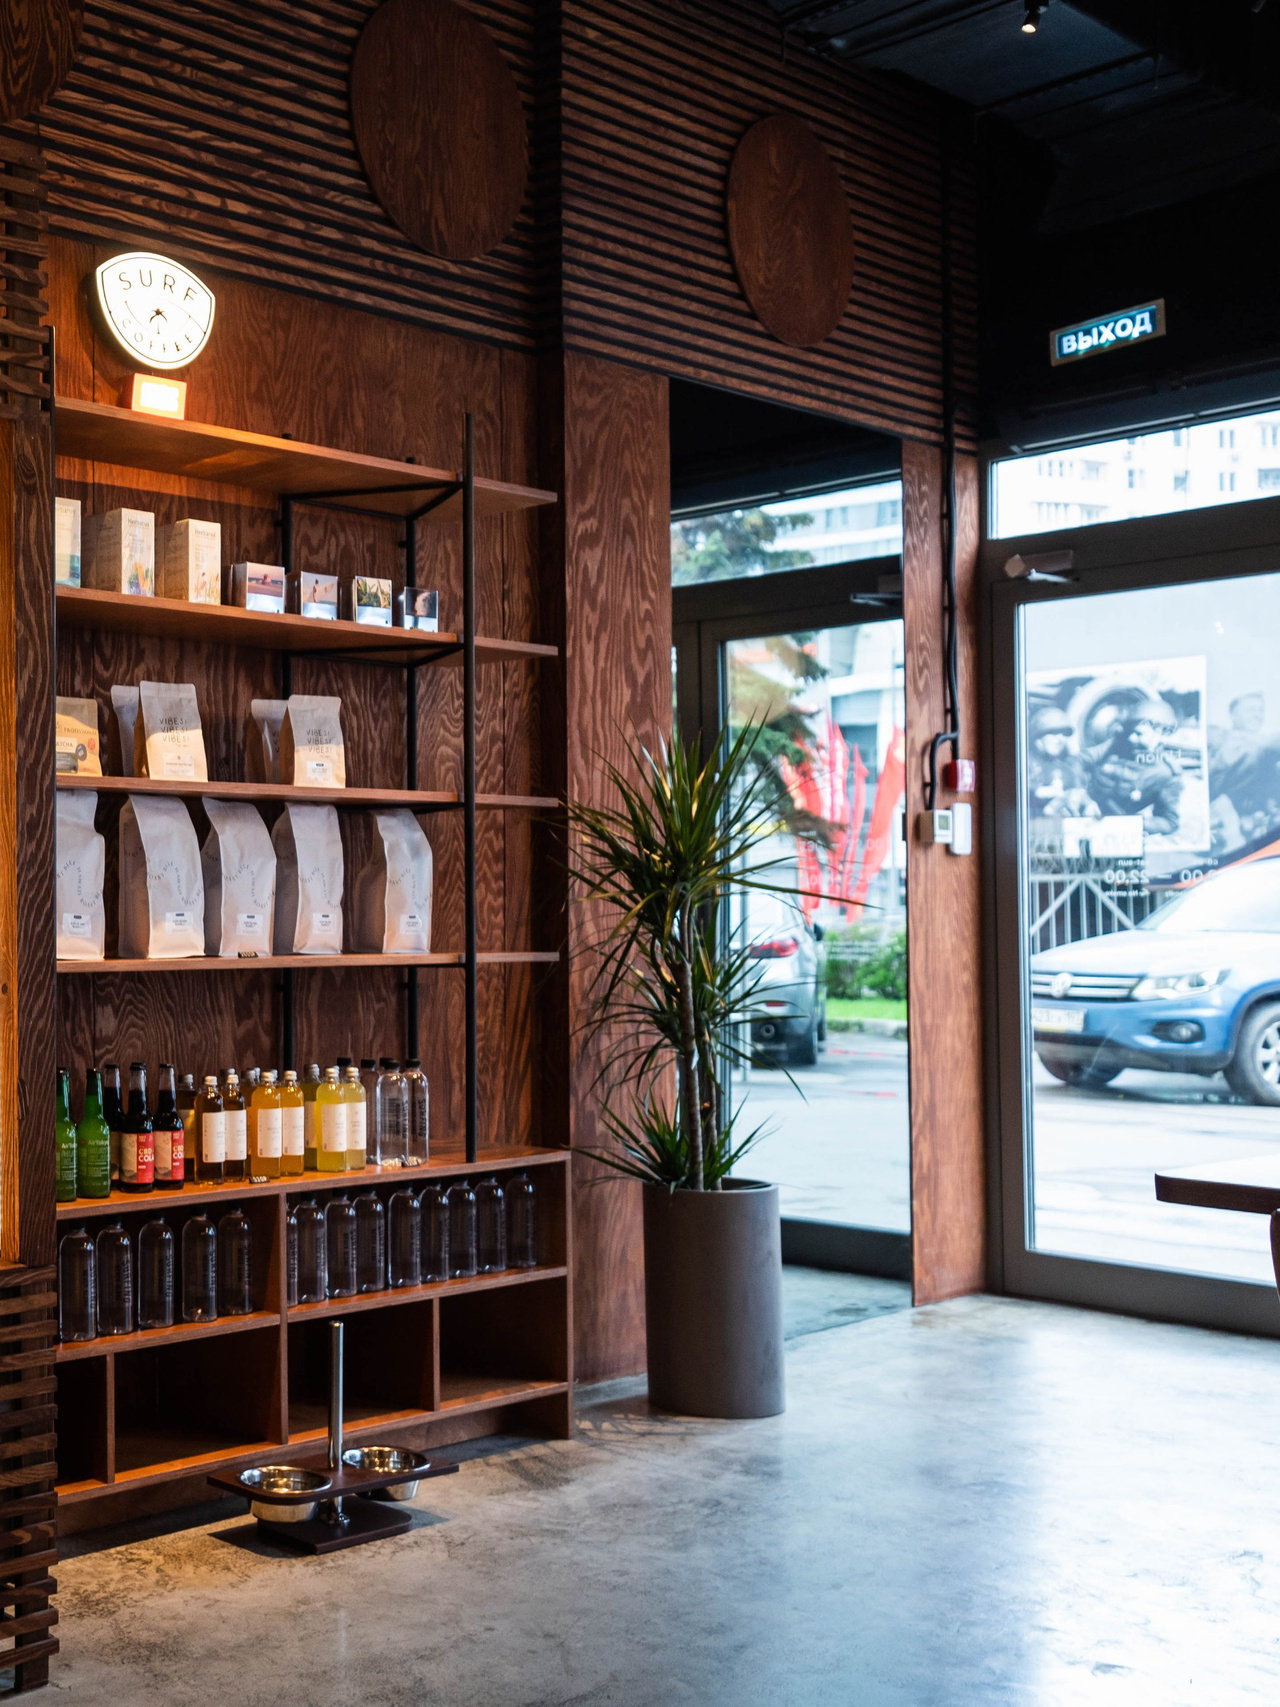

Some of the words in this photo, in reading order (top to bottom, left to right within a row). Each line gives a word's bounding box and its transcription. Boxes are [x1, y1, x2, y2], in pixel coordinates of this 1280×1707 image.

[118, 269, 198, 302] SURF
[1061, 311, 1153, 355] ВЫХОД
[56, 740, 74, 748] ATCHA
